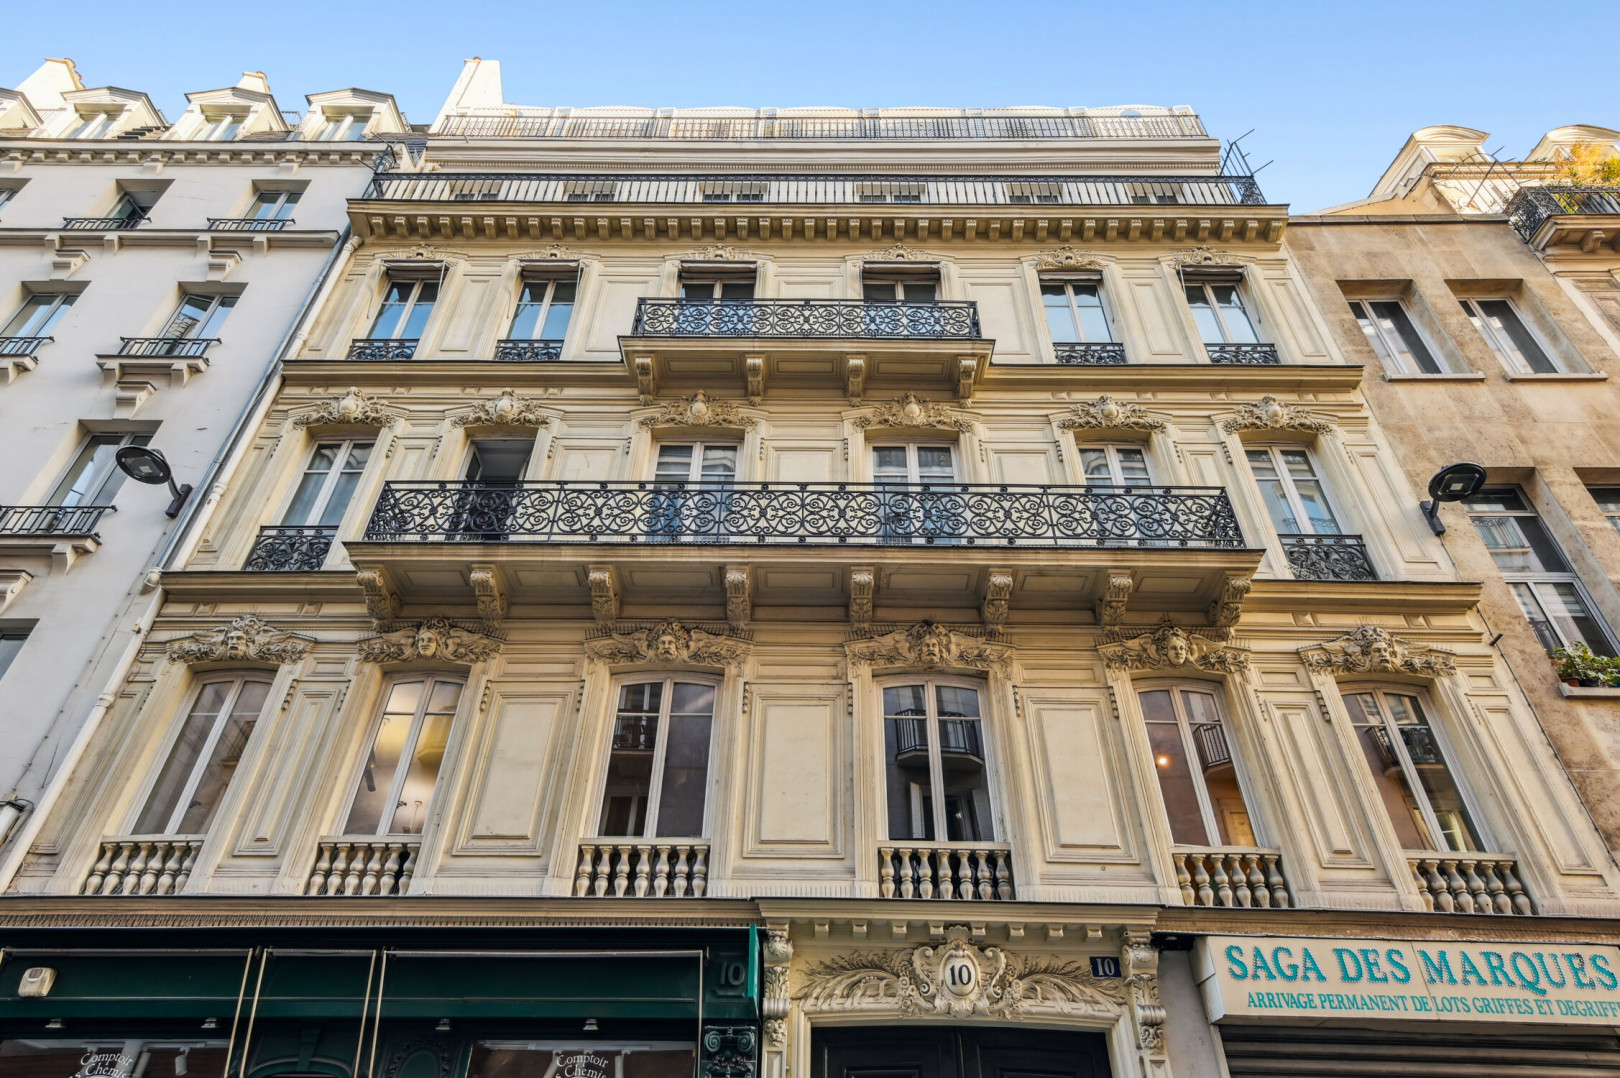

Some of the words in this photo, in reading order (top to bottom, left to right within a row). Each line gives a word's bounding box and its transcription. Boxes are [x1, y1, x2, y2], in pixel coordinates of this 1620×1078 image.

[720, 961, 745, 985] 10
[949, 964, 971, 986] 10
[1096, 958, 1115, 976] 10
[1225, 945, 1327, 982] SAGA
[1333, 947, 1411, 985] DES
[1417, 949, 1618, 997] MARQUES
[1248, 992, 1317, 1009] ARRIVAGE
[1319, 994, 1408, 1011] PERMANENT
[1412, 996, 1432, 1012] DE
[1434, 997, 1470, 1013] LOTS
[1472, 997, 1534, 1015] GRIFFES
[1534, 999, 1554, 1015] ET
[1555, 999, 1620, 1018] DEGRIFF
[80, 1053, 133, 1066] Comptoir
[556, 1055, 609, 1068] Comptoir
